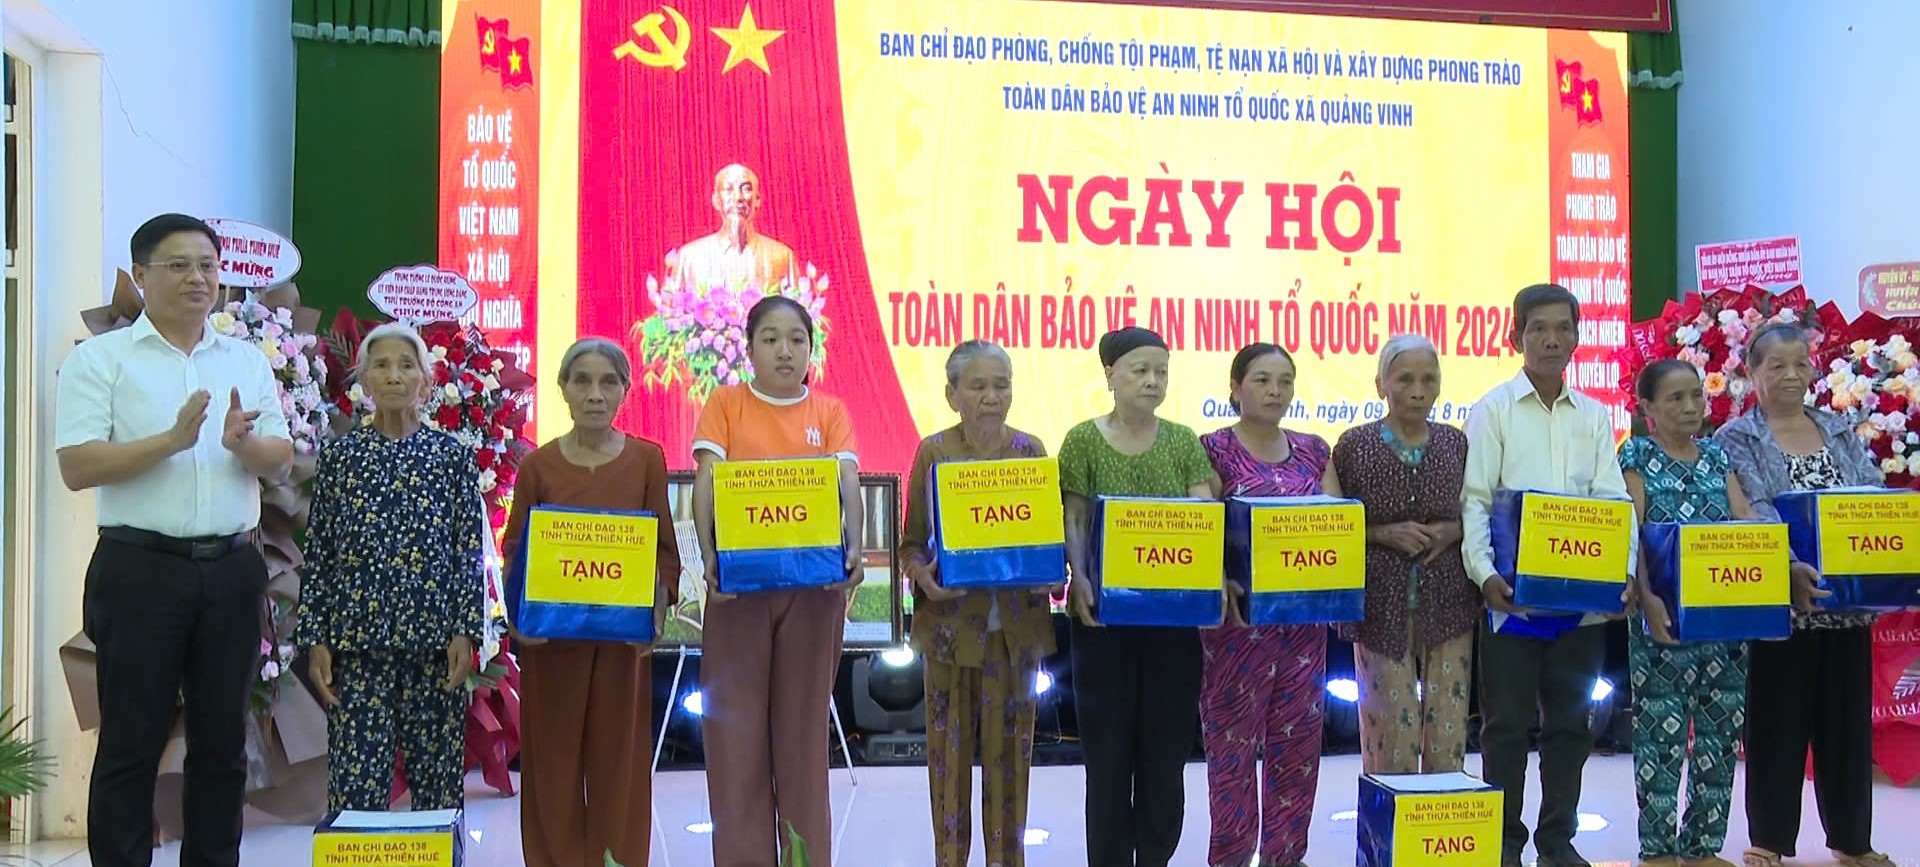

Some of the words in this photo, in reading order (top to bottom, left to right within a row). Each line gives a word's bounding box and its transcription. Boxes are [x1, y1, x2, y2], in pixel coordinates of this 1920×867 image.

[880, 33, 914, 57] BAN
[920, 27, 948, 58] CHỈ
[953, 35, 986, 65] ĐẠO
[992, 32, 1053, 66] PHÒNG,
[1059, 33, 1114, 66] CHỐNG
[1119, 39, 1144, 71] TỘI
[1150, 44, 1200, 74] PHẠM,
[1206, 43, 1224, 76] TỆ
[1229, 48, 1263, 77] NẠN
[1268, 46, 1288, 73] XÃ
[1293, 48, 1319, 80] HỘI
[1323, 48, 1344, 77] VÀ
[1348, 50, 1377, 78] XÂY
[1383, 56, 1423, 85] DỰNG
[1429, 59, 1479, 84] PHONG
[1484, 58, 1521, 86] TRÀO
[1002, 82, 1046, 111] TOÀN
[1052, 83, 1085, 113] DÂN
[1091, 82, 1122, 114] BẢO
[1128, 86, 1147, 120] VỆ
[1152, 93, 1175, 116] AN
[1180, 94, 1218, 119] NINH
[1224, 86, 1245, 119] TỔ
[1248, 89, 1290, 122] QUỐC
[1295, 94, 1315, 122] XÃ
[1320, 93, 1372, 125] QUẢNG
[1377, 103, 1413, 127] VINH
[468, 105, 493, 143] BẢO
[497, 109, 512, 149] VỆ
[463, 150, 479, 189] TỔ
[482, 151, 516, 192] QUỐC
[1571, 152, 1594, 179] THAM
[1596, 153, 1610, 179] GIA
[459, 201, 485, 241] VIỆT
[489, 206, 518, 236] NAM
[1017, 162, 1244, 248] NGÀY
[1265, 170, 1401, 266] HỘI
[1566, 193, 1594, 220] PHONG
[1596, 189, 1616, 221] TRÀO
[468, 247, 484, 281] XÃ
[488, 247, 510, 288] HỘI
[1580, 229, 1596, 262] DÂN
[1598, 228, 1614, 263] BẢO
[1616, 232, 1626, 269] VỆ
[483, 294, 522, 329] NGHĨA
[889, 280, 962, 347] TOÀN
[973, 282, 1030, 348] DÂN
[1041, 276, 1096, 349] BẢO
[1150, 297, 1184, 351] AN
[1194, 297, 1260, 352] NINH
[1269, 278, 1301, 353] TỔ
[1310, 282, 1379, 360] QUỐC
[1456, 305, 1515, 358] 2024
[1600, 315, 1626, 352] NHIỆM
[1317, 400, 1358, 423] ngày
[1364, 402, 1384, 419] 09
[1443, 402, 1452, 420] 8
